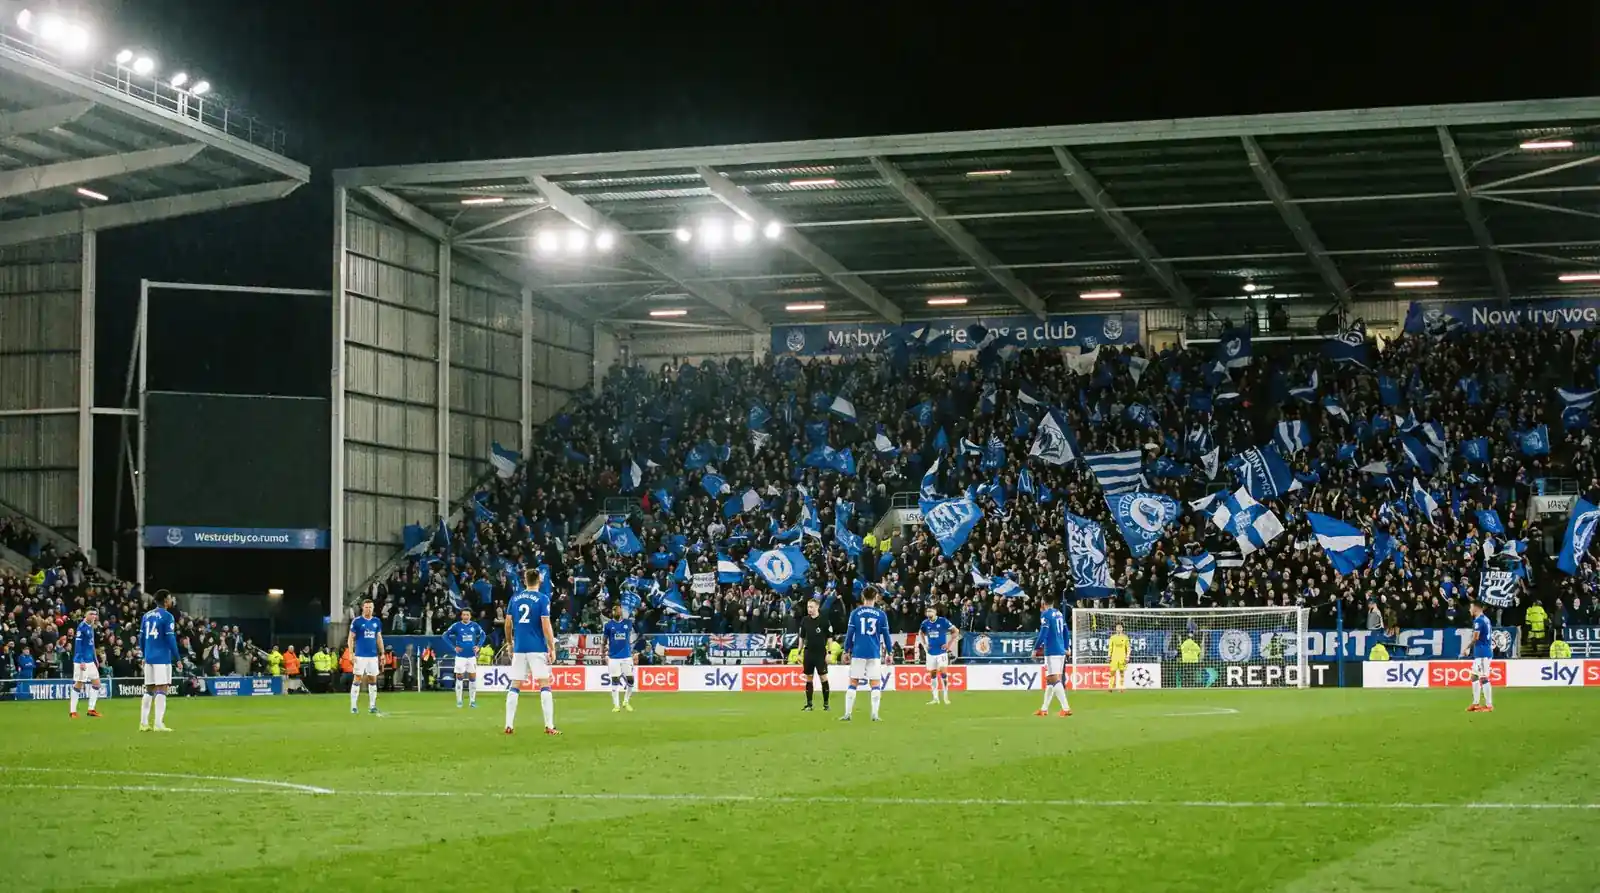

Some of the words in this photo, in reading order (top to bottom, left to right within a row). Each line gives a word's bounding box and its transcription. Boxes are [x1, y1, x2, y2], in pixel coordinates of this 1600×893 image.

[1033, 321, 1077, 340] club
[519, 603, 530, 623] 2
[145, 620, 159, 640] 14
[860, 617, 877, 635] 13
[642, 670, 675, 687] bet
[705, 668, 738, 690] sky
[745, 670, 808, 690] sports
[899, 671, 963, 690] spots
[1002, 667, 1038, 690] sky
[1386, 663, 1425, 687] sky
[1540, 661, 1579, 685] sky
